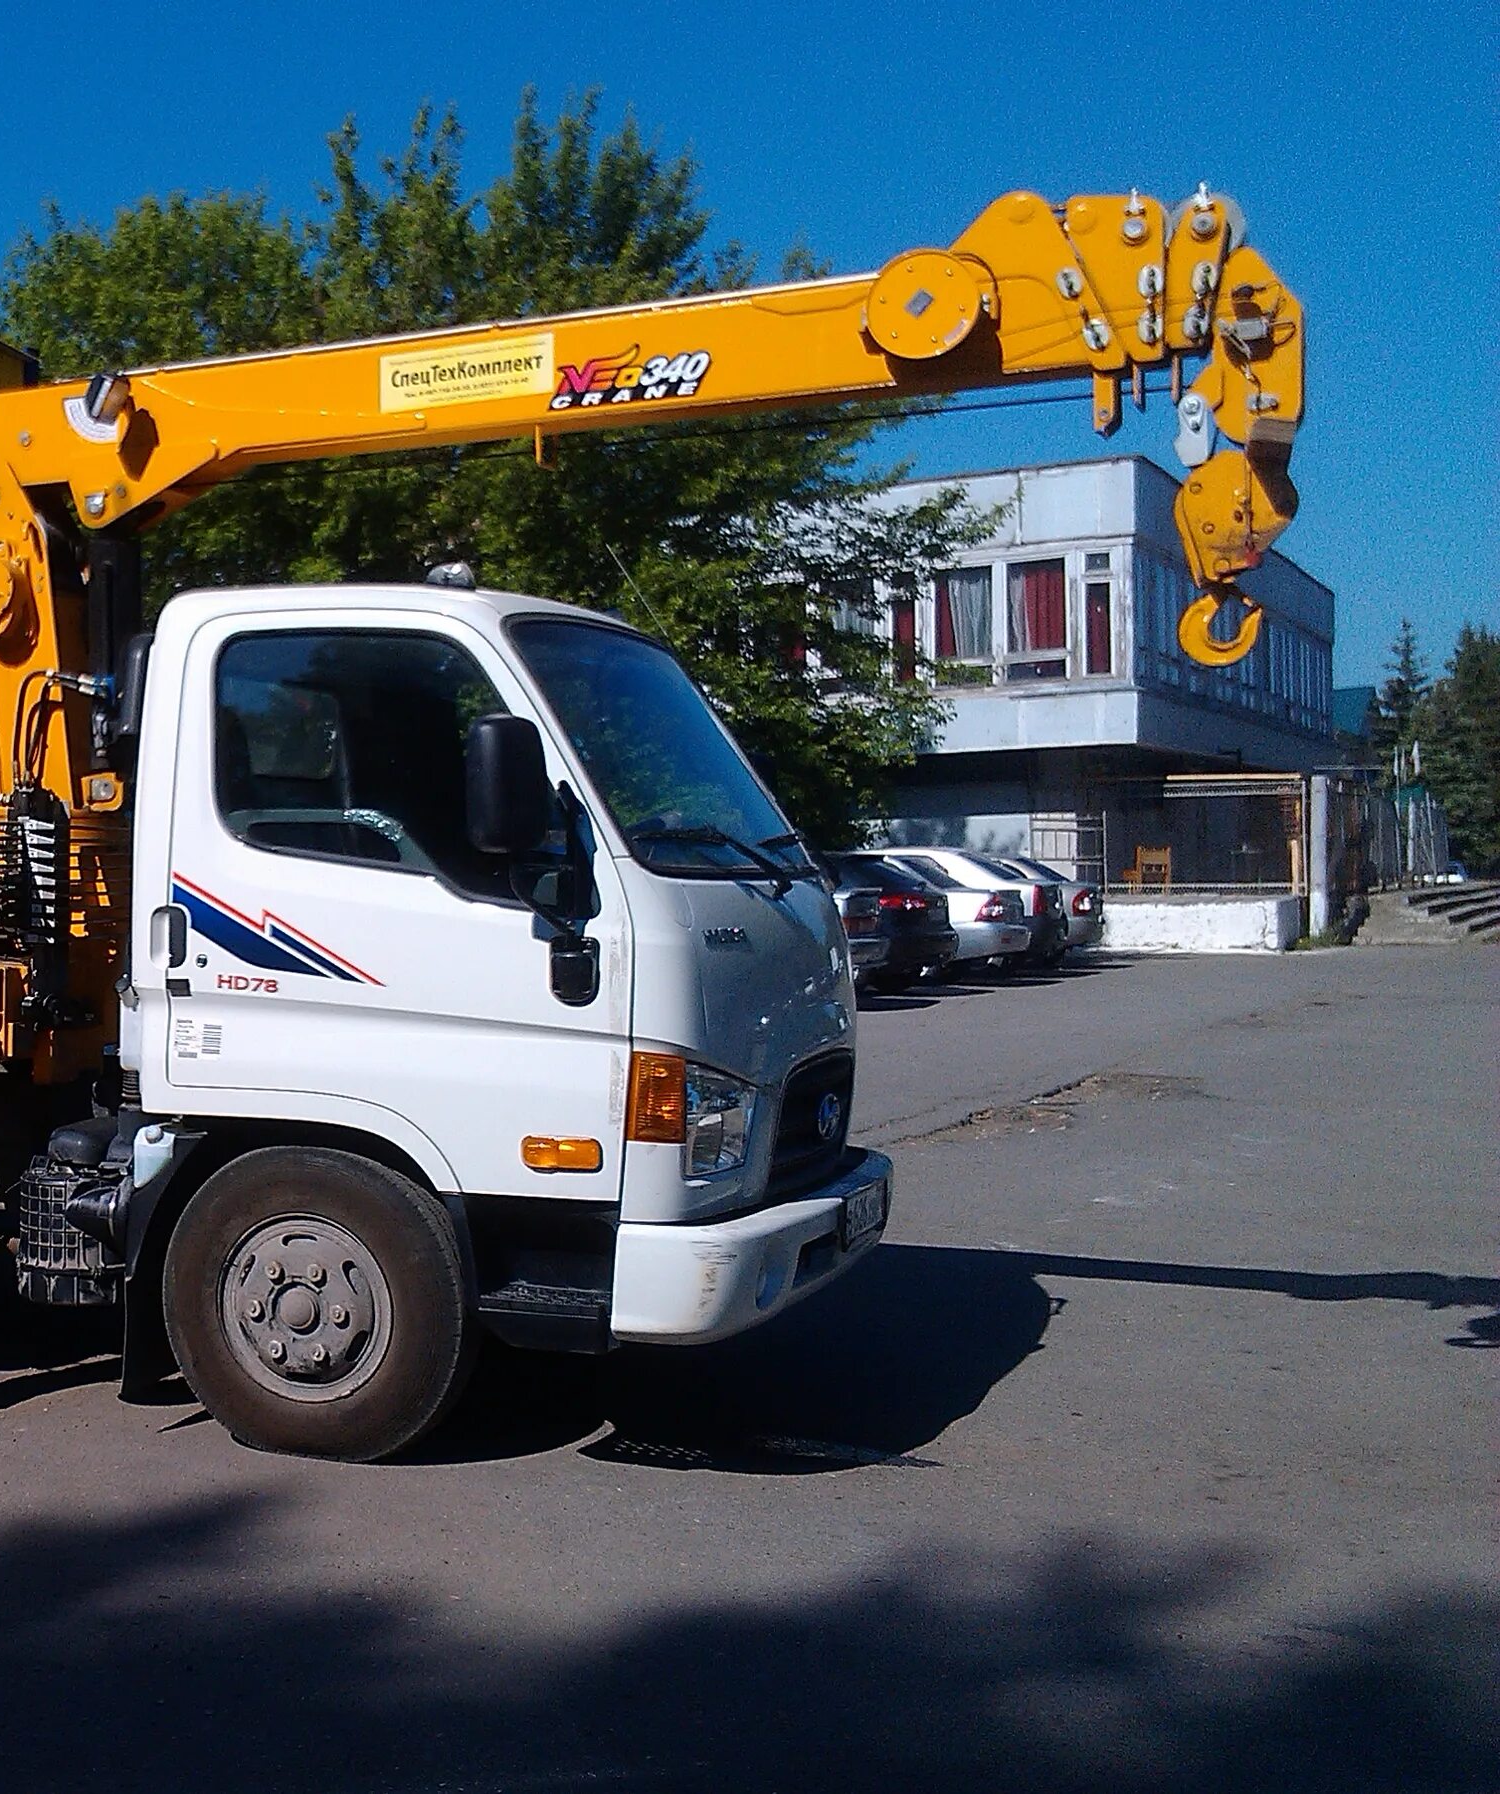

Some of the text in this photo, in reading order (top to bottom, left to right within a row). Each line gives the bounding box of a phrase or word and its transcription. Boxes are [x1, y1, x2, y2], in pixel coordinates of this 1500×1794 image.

[391, 355, 543, 388] СпецТехКомплект
[640, 351, 711, 387] 340
[551, 382, 698, 409] CRANE
[217, 974, 279, 993] HD78
